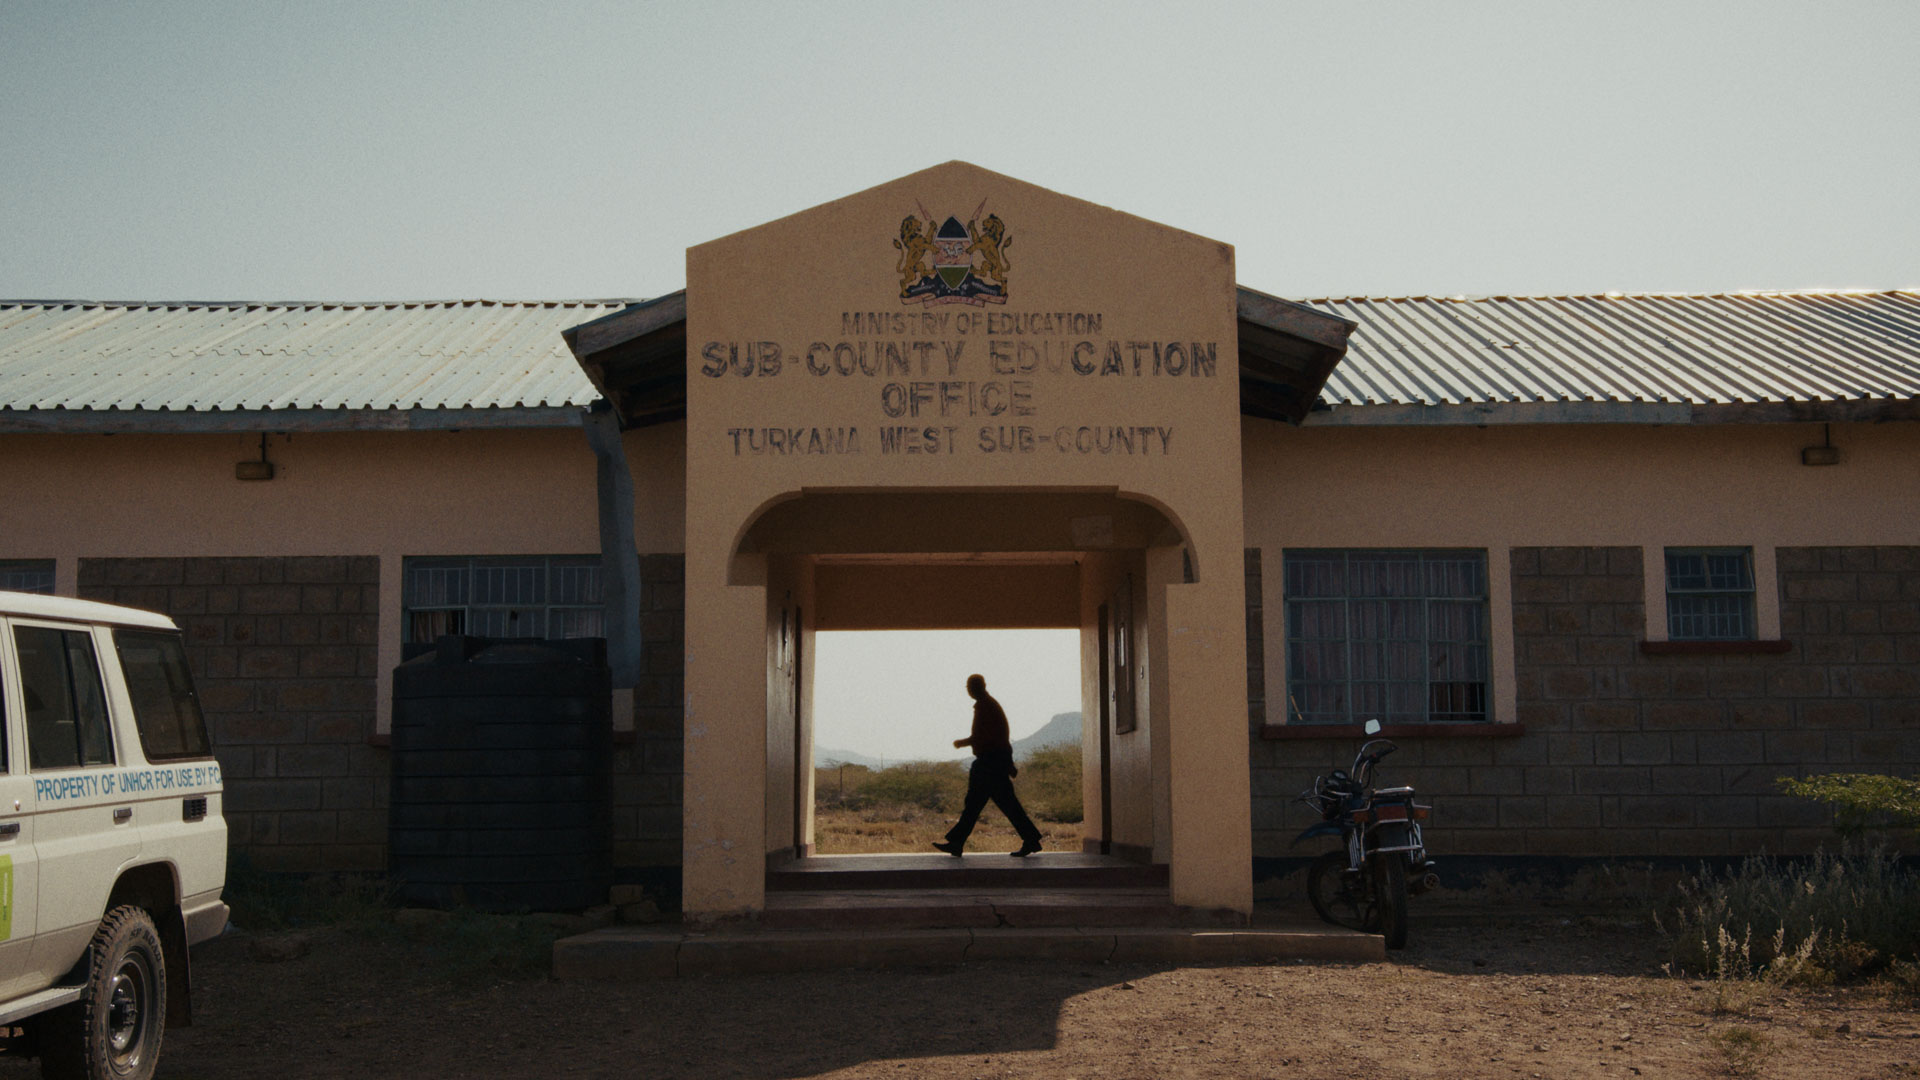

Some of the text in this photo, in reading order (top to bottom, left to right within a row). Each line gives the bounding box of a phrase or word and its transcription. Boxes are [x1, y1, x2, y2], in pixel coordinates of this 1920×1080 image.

[841, 312, 1102, 336] MINISTRY OF EDUCATION
[701, 340, 1217, 378] SUB-COUNTY EDUCATION
[881, 381, 1036, 418] OFFICE
[728, 426, 1173, 456] TURKANA WEST SUB-COUNTY
[36, 775, 98, 801] PROPERTY
[101, 774, 115, 794] OF
[118, 771, 154, 792] UNHCR
[154, 769, 175, 790] FOR
[175, 768, 194, 788] USE
[195, 767, 206, 785] BY
